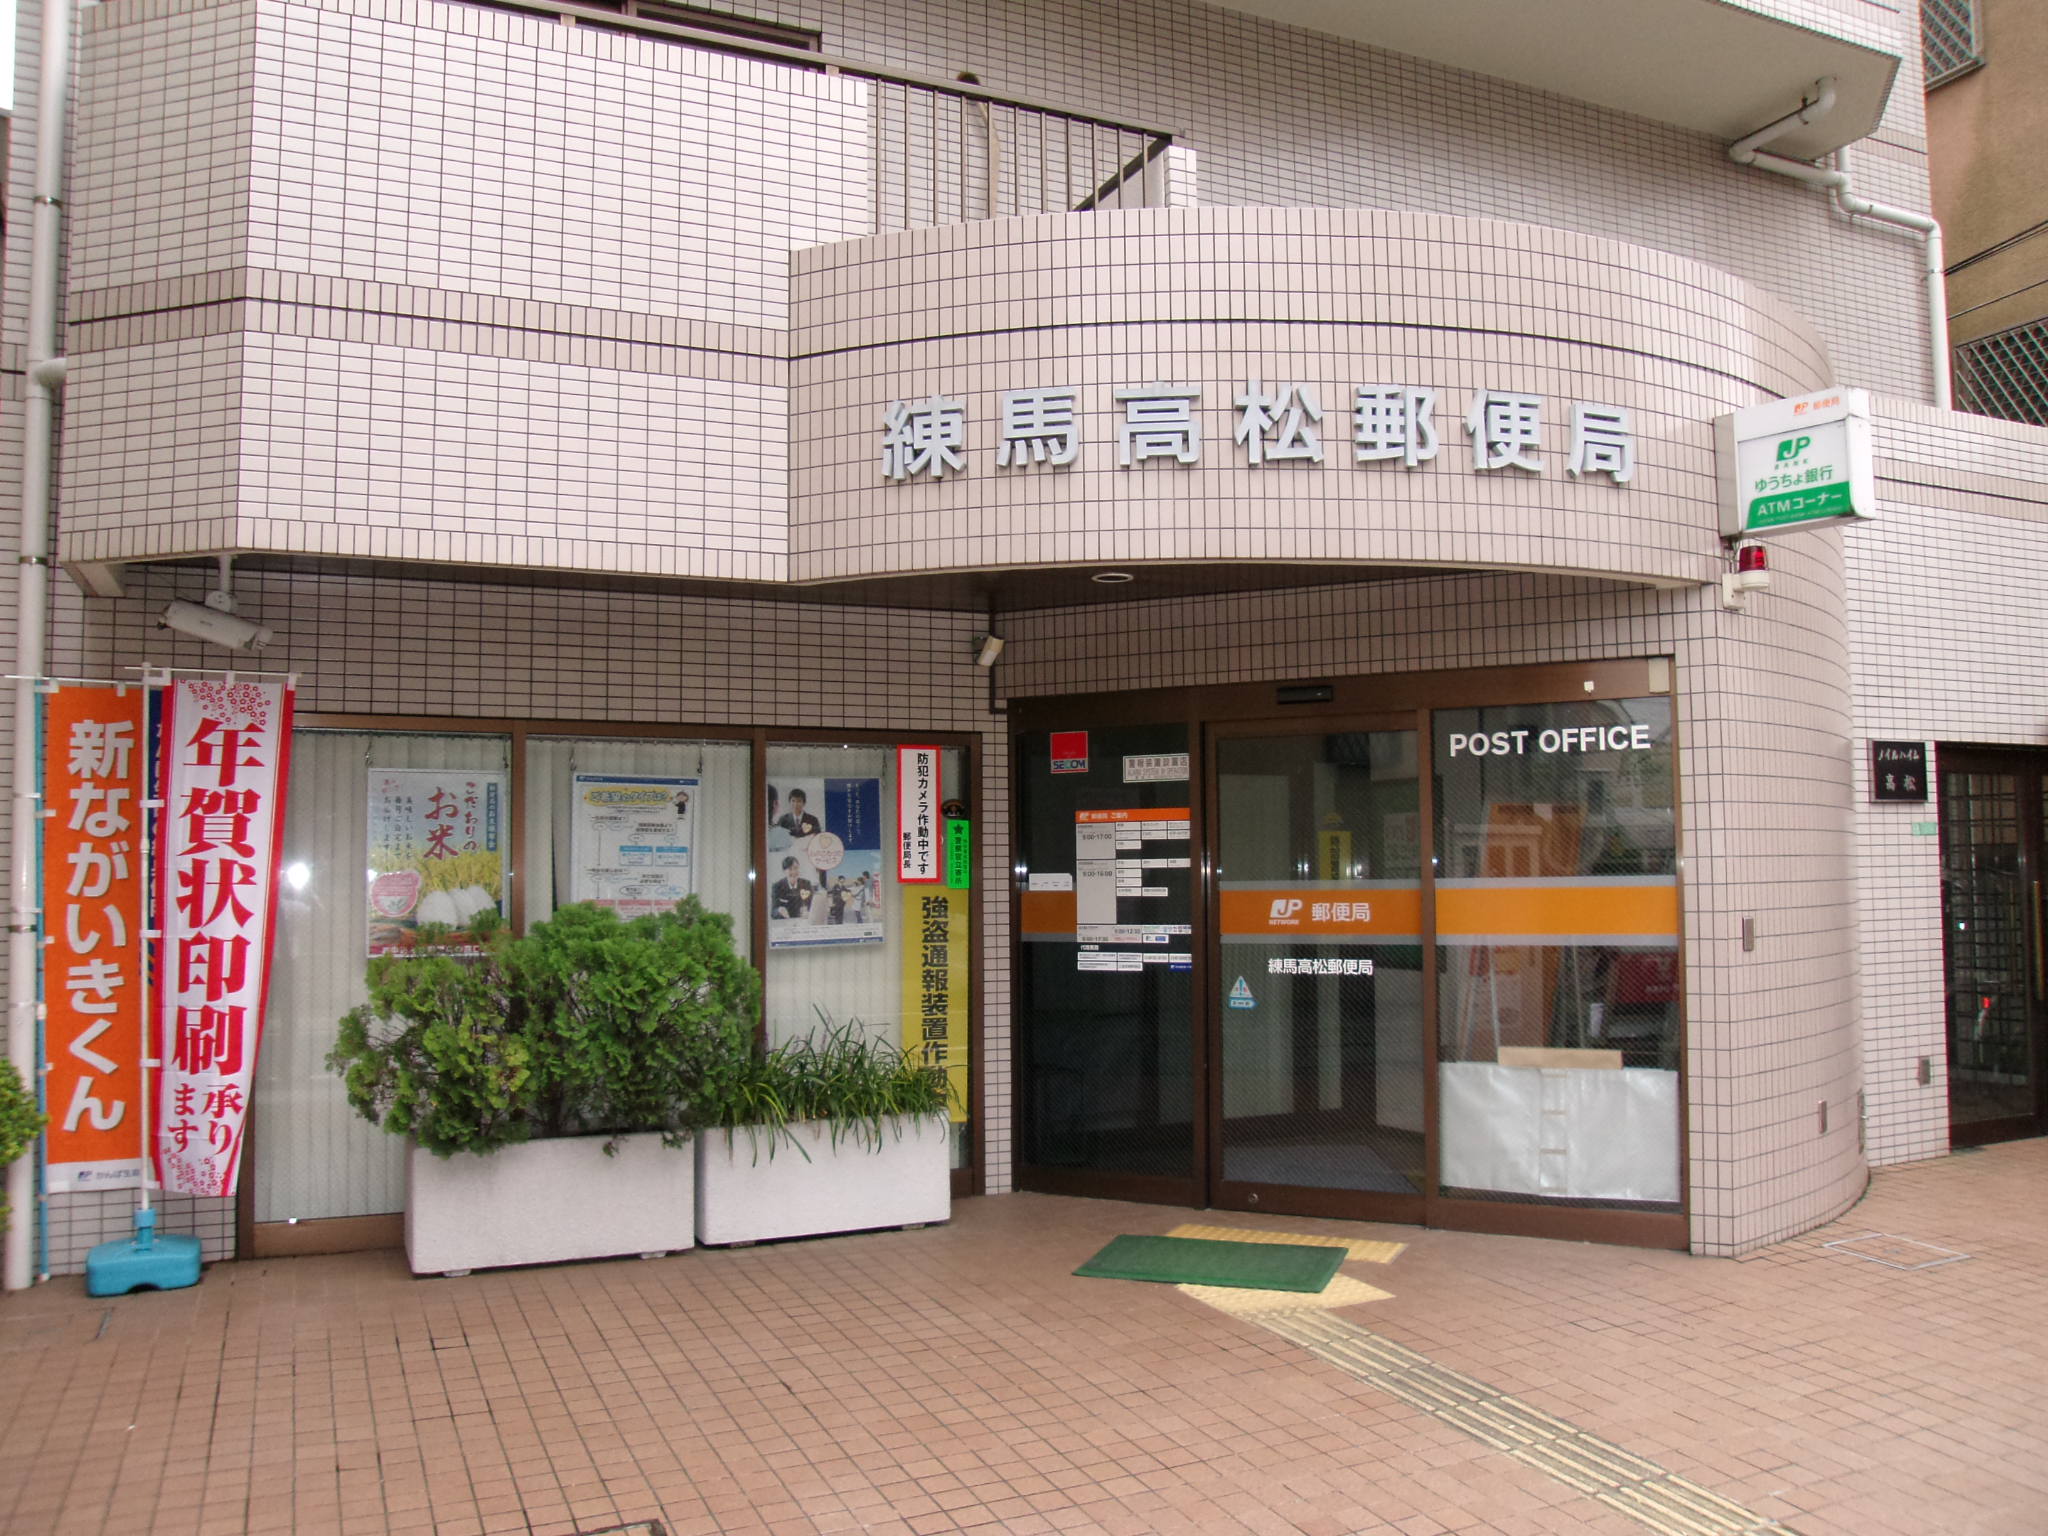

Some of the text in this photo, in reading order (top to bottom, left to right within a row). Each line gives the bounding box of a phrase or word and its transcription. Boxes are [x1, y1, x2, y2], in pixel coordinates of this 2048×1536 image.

[881, 380, 1637, 484] 練馬高松郵便局
[1754, 464, 1833, 493] ゆうちょ銀行
[1757, 491, 1843, 516] ATMコーナー
[1052, 760, 1086, 770] SECOM
[1449, 724, 1651, 757] POST OFFICE
[1885, 773, 1917, 792] 高松
[423, 786, 460, 861] お米
[464, 781, 480, 851] こだわりの
[917, 753, 930, 875] 防犯カメラ作動中です
[903, 832, 912, 869] 郵便局長
[172, 716, 266, 1077] 年賀状印刷
[1311, 902, 1371, 922] 郵便局
[62, 718, 136, 1133] 新ながいきくん
[1268, 957, 1374, 976] 練馬高松郵便局
[167, 1083, 200, 1153] ます
[200, 1084, 244, 1155] 承り
